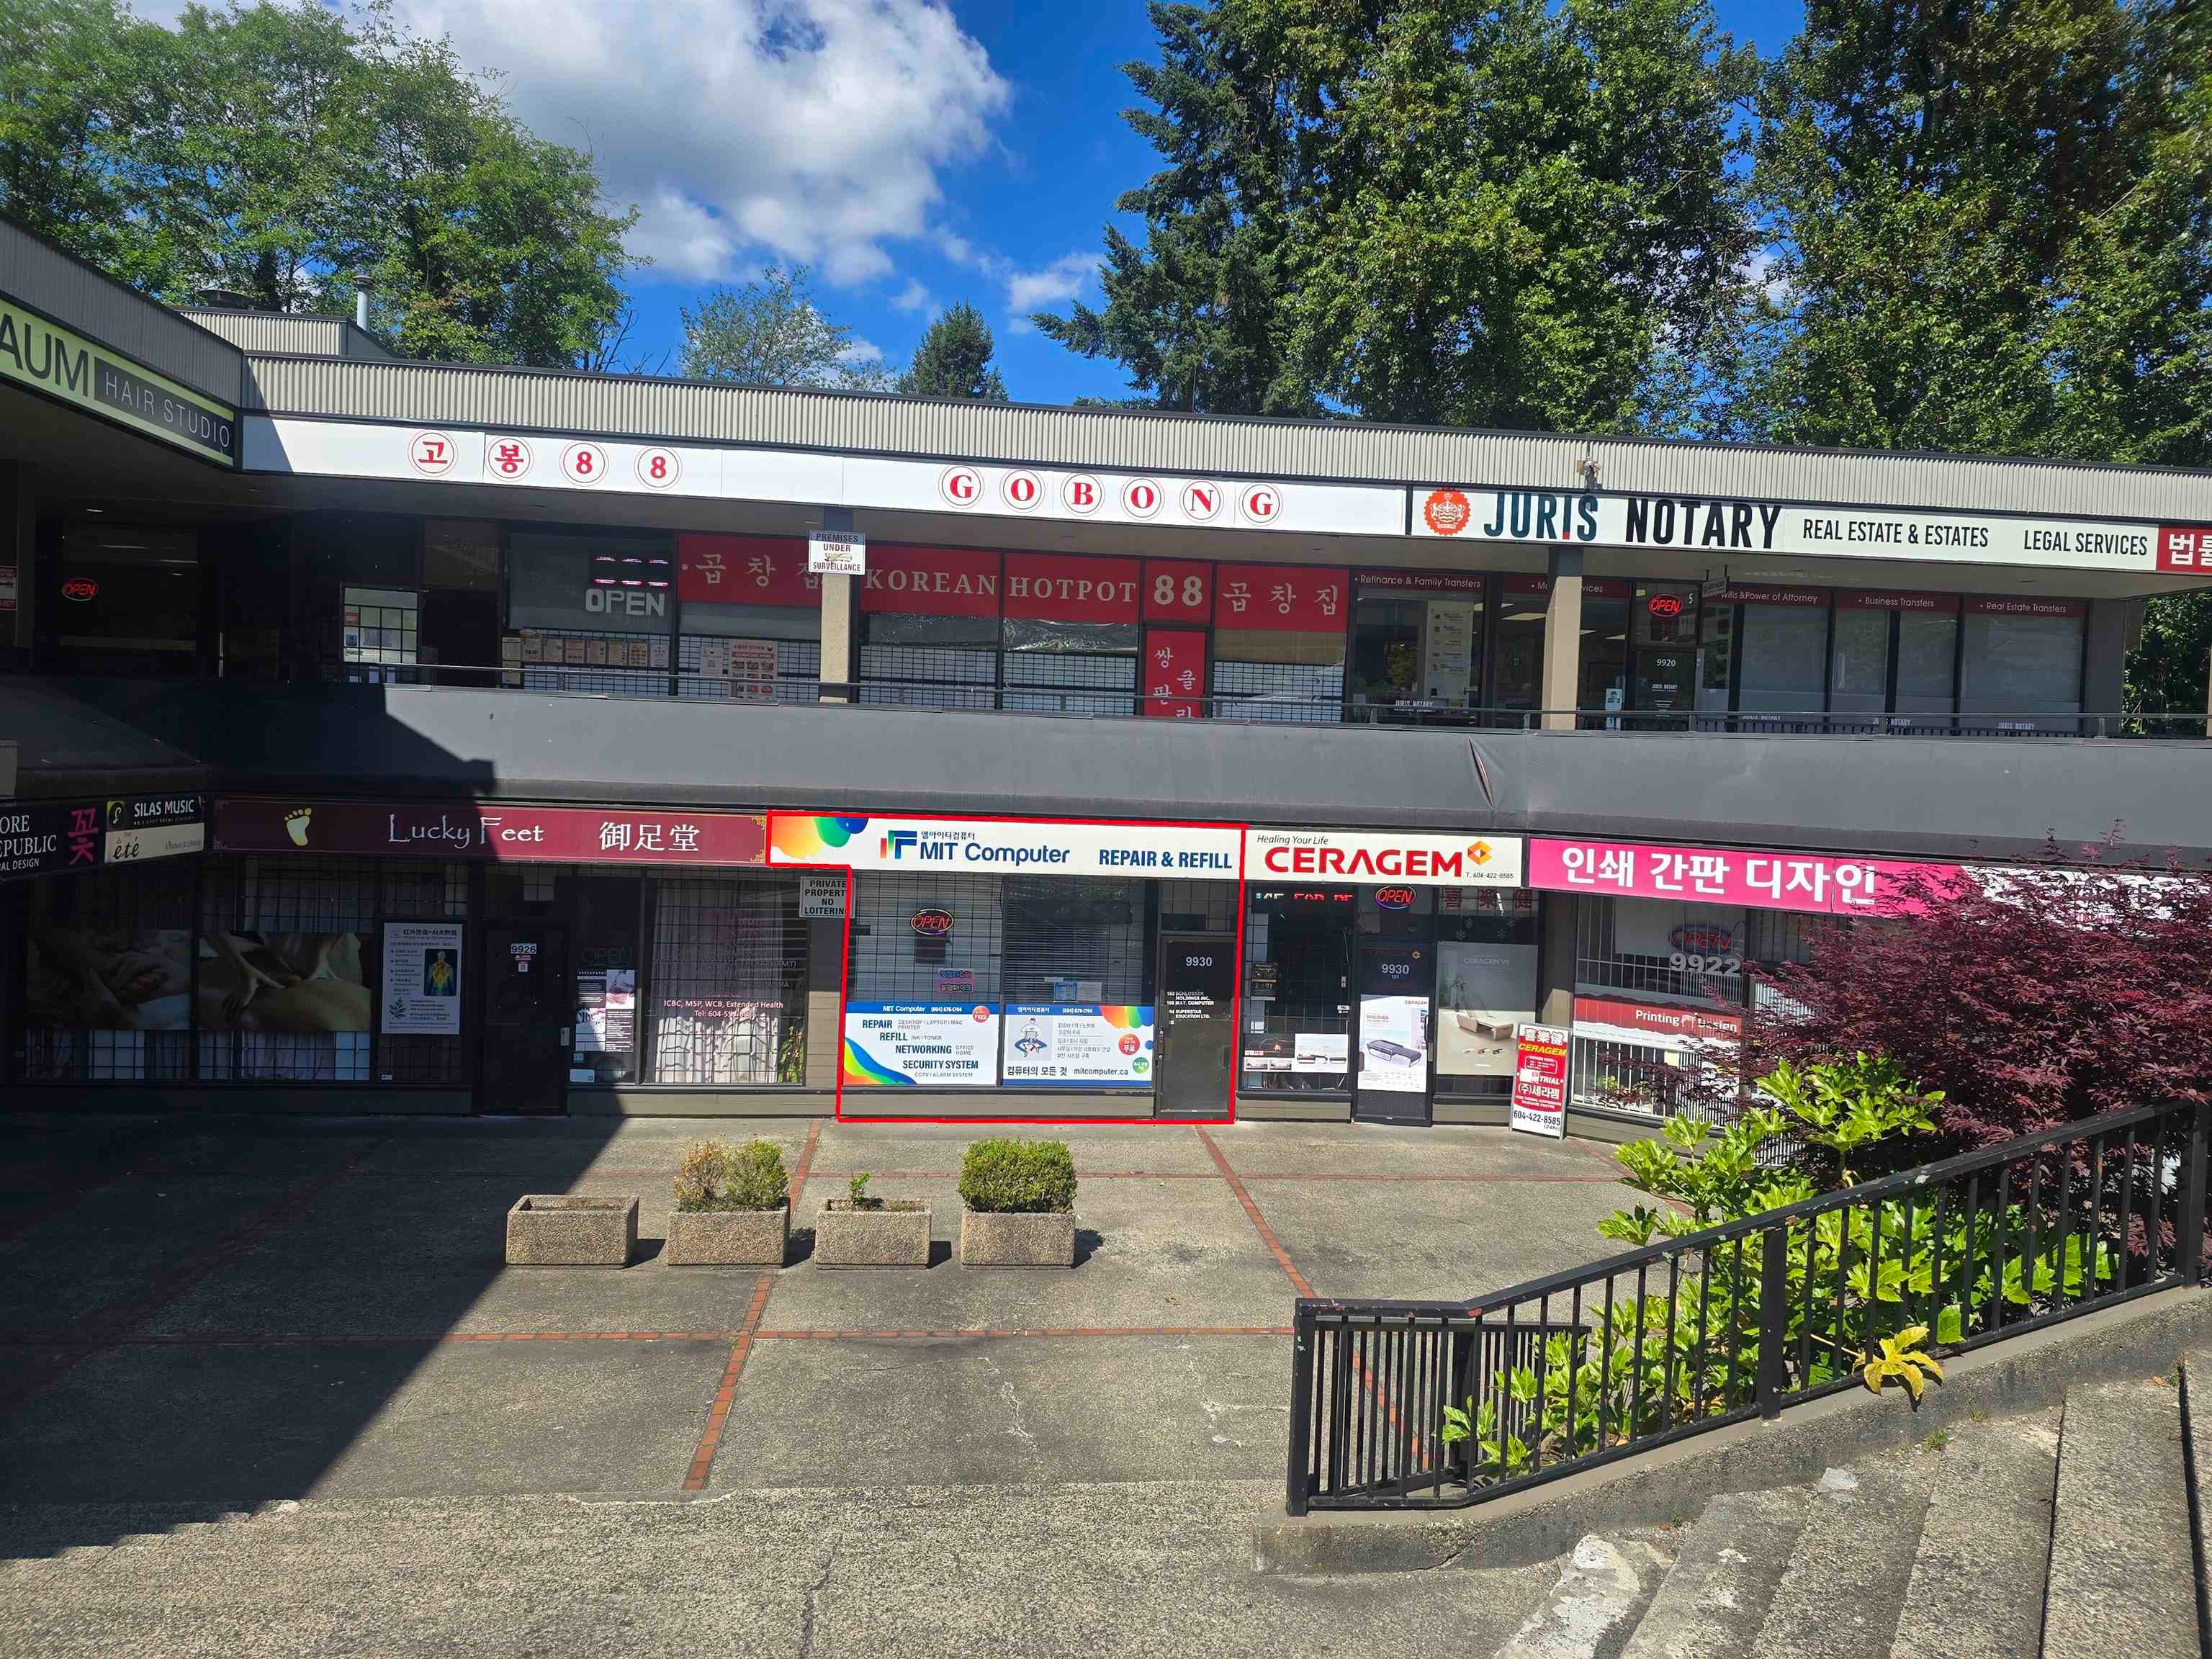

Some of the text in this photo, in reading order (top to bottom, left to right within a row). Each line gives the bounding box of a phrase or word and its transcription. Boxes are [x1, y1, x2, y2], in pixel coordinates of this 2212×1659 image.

[105, 370, 154, 415] HAIR
[163, 398, 230, 447] STUDIO
[1483, 491, 1783, 549] JURIS NOTARY
[817, 533, 858, 543] PREMISES
[1802, 518, 1989, 548] REAL ESTATE & ESTATES
[823, 543, 851, 552] UNDER
[2023, 529, 2148, 556] LEGAL SERVICES
[813, 562, 861, 572] SURVEILLANCE
[865, 567, 1203, 606] KOREAN HOTPOT 88
[1360, 575, 1403, 585] Refinance
[1414, 576, 1442, 588] Family
[1444, 578, 1481, 588] Transfers
[65, 583, 96, 595] OPEN
[585, 588, 665, 617] OPEN
[1649, 598, 1681, 612] OPEN
[1782, 593, 1819, 604] Attorney
[1865, 596, 1935, 608] Business Transfers
[1986, 601, 2067, 613] Real Estate Transfers
[1656, 658, 1676, 667] 9920
[133, 799, 195, 818] SILAS MUSIC
[388, 814, 544, 850] Lucky Feet
[598, 821, 701, 853] 御足堂
[921, 830, 976, 841] 엠아이티컴퓨터
[1256, 834, 1329, 845] Healing Your Life
[919, 841, 1071, 866] MIT Computer
[1099, 849, 1233, 869] REPAIR & REFILL
[12, 858, 40, 871] DESIGN
[1264, 845, 1463, 878] CERAGEM
[1561, 847, 1876, 905] 인쇄 간판 디자인
[804, 889, 850, 897] PROPERT
[1377, 889, 1413, 903] OPEN
[913, 914, 950, 929] OPEN
[1186, 956, 1213, 967] 9930
[1670, 952, 1741, 978] 9922
[1381, 963, 1410, 974] 9930
[862, 1020, 893, 1029] REPAIR
[1635, 1010, 1738, 1033] Printing Design
[879, 1032, 908, 1041] REFILL
[895, 1045, 952, 1054] NETWORKING
[1518, 1043, 1568, 1056] CERAGEM
[902, 1060, 979, 1069] SECURITY SYSTEM
[1007, 1066, 1068, 1076] 컴퓨터의 모든 것
[1074, 1068, 1129, 1076] mitcomputer.ca
[1539, 1076, 1560, 1084] TRIAL
[1514, 1110, 1561, 1126] 604-422-8585
